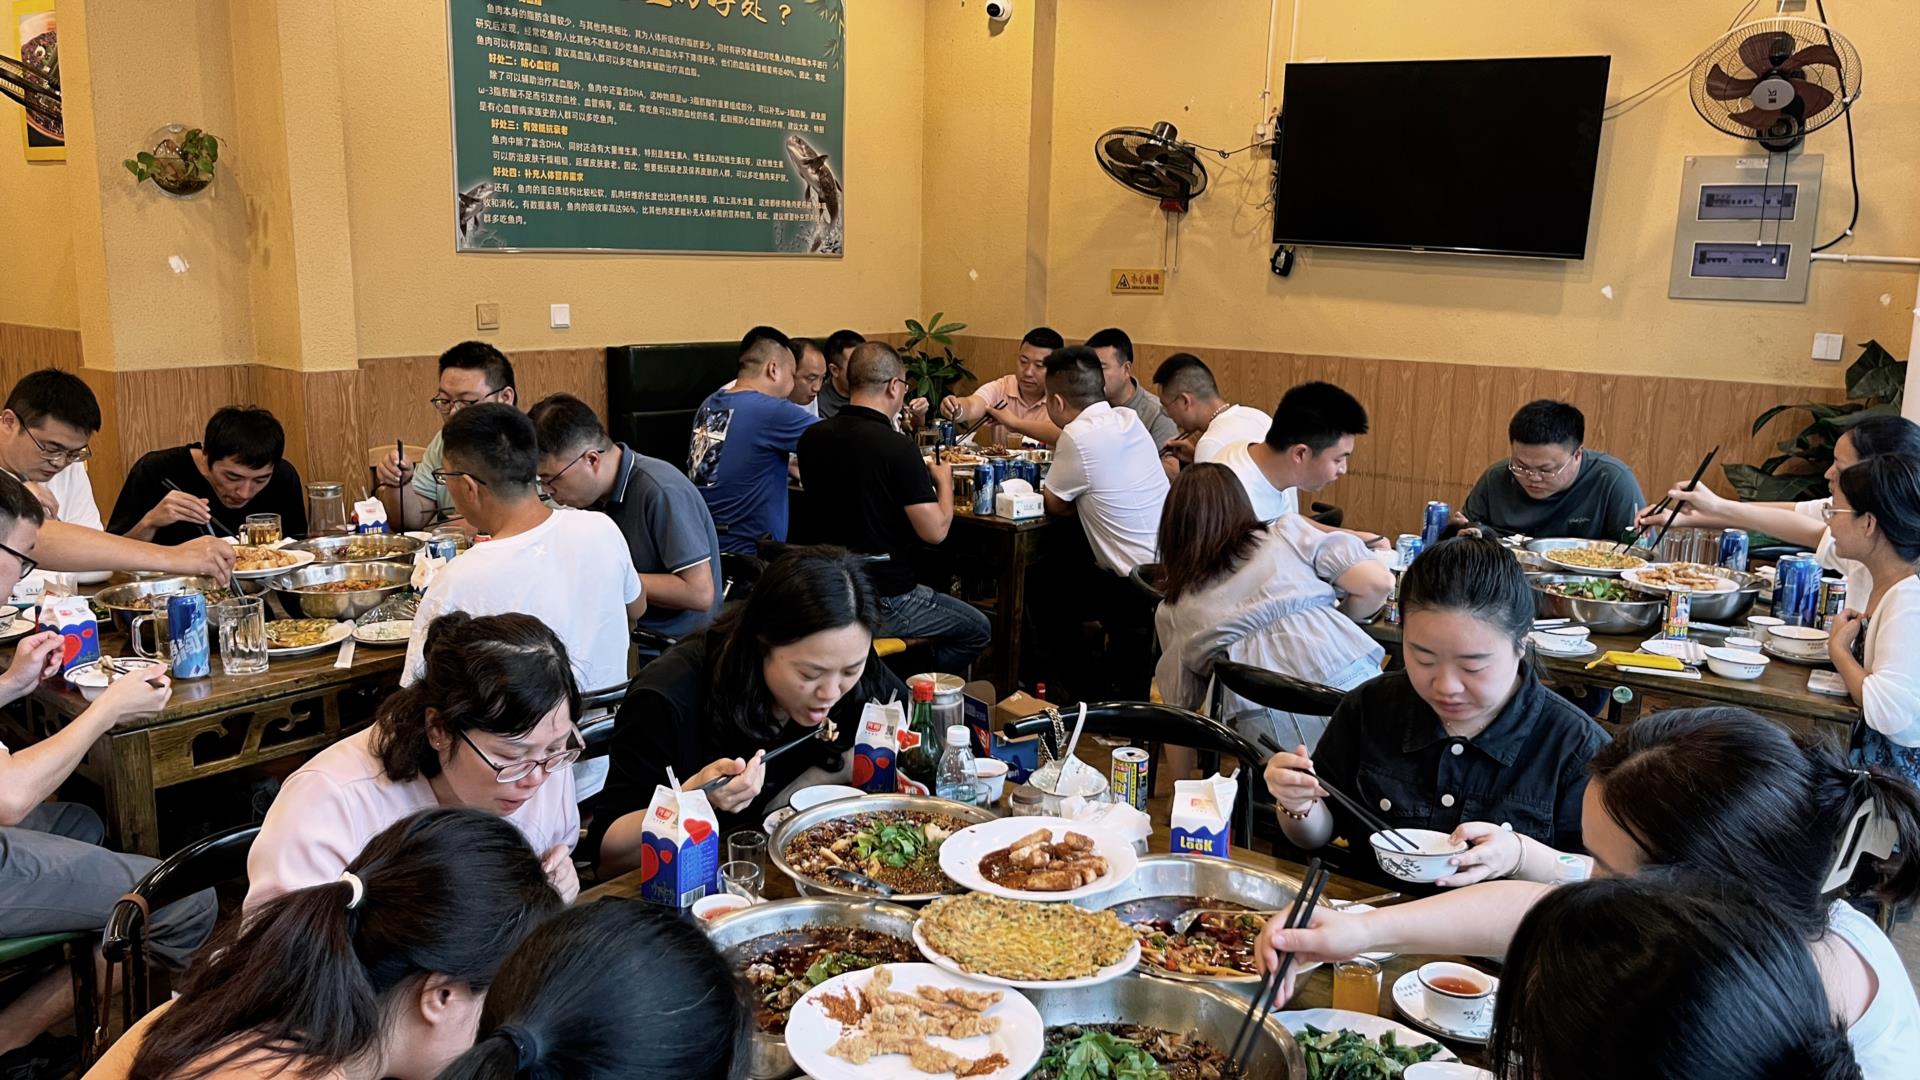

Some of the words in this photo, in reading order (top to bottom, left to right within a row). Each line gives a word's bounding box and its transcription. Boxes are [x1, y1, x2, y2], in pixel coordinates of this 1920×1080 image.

[491, 118, 569, 136] 好处三：有效抵抗衰老
[493, 167, 585, 182] 好处四：补充人体营养需求
[483, 214, 527, 225] 群多吃鱼肉。
